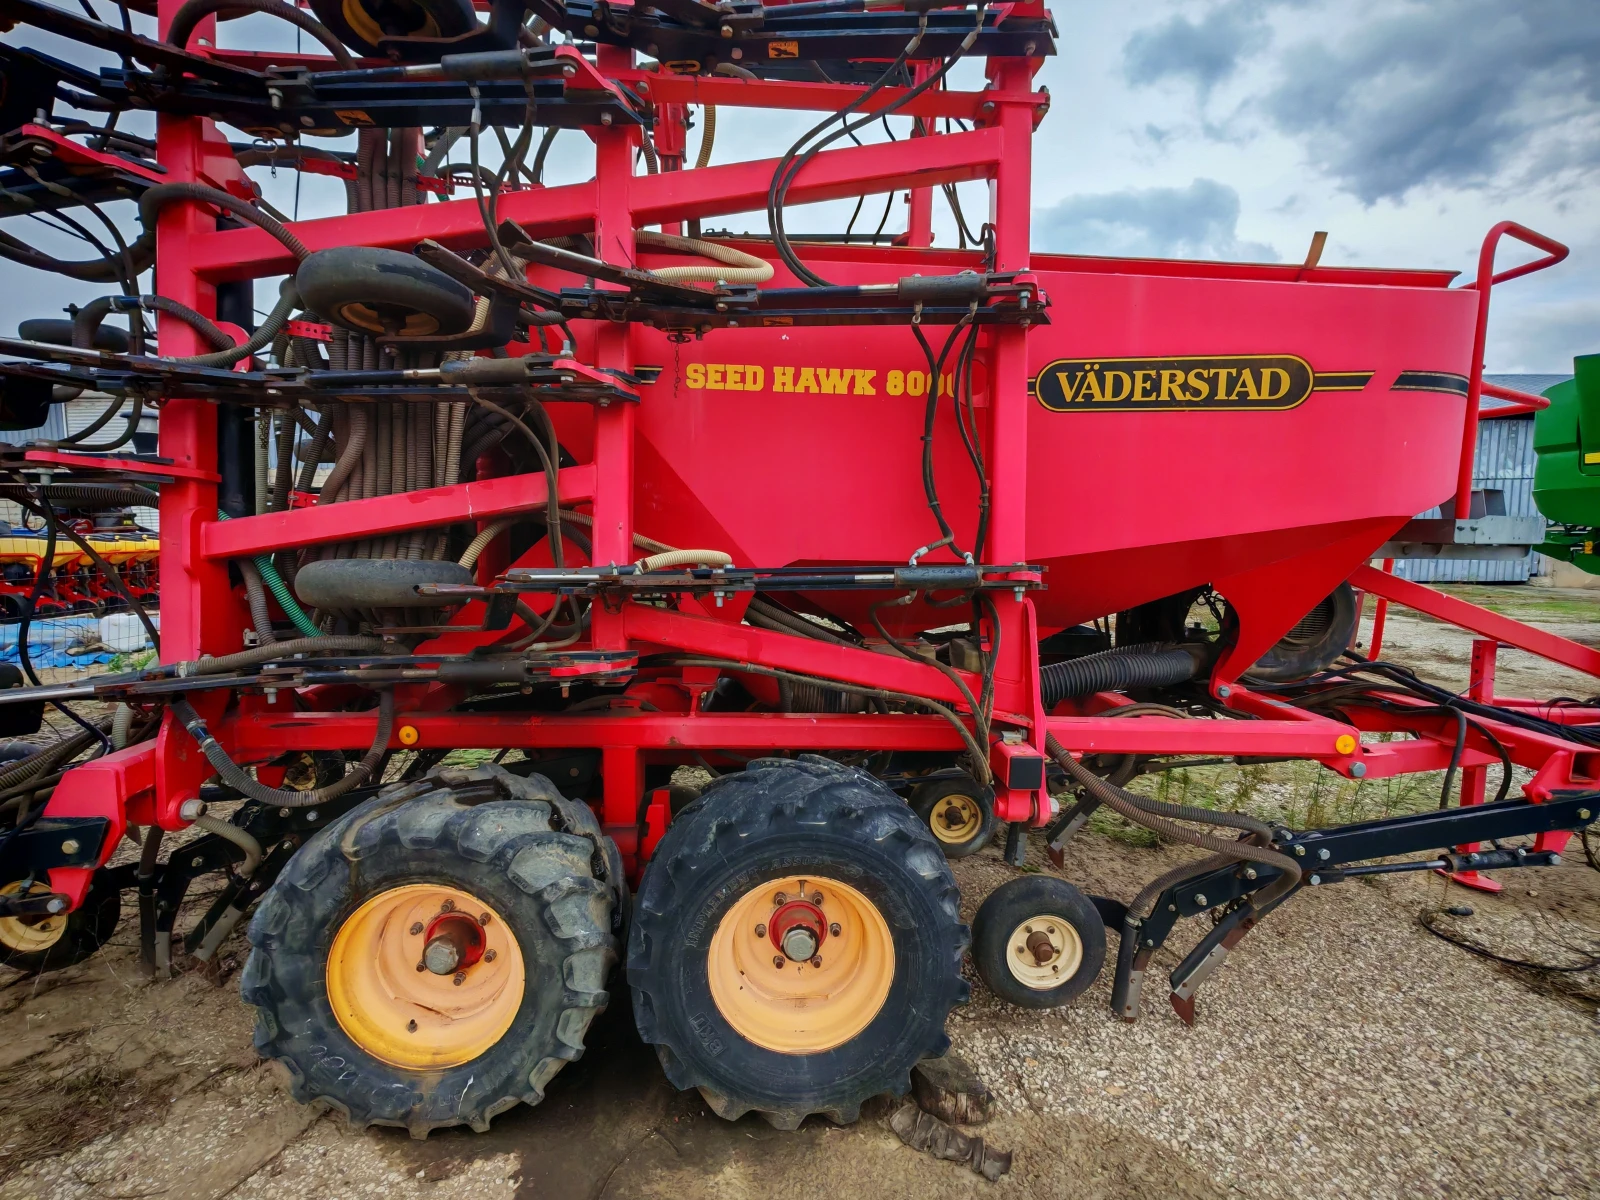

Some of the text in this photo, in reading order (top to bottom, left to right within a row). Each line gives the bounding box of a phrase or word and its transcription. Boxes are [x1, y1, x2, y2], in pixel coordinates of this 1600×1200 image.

[685, 362, 765, 390] SEED
[772, 366, 877, 396] HAWK
[1055, 363, 1292, 402] VÄDERSTAD
[690, 1015, 726, 1056] BKT
